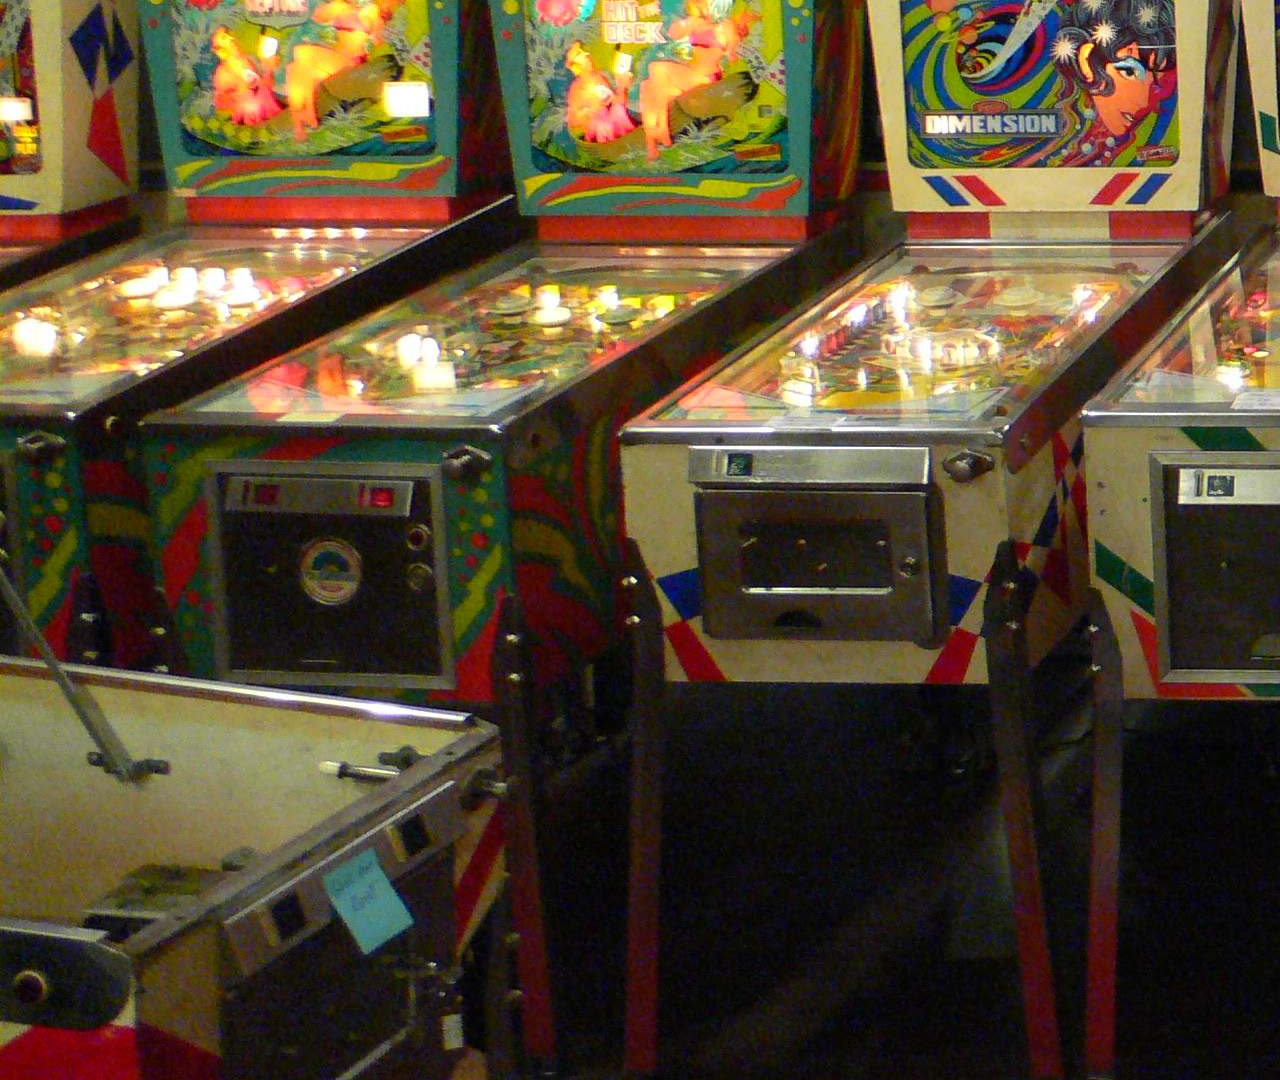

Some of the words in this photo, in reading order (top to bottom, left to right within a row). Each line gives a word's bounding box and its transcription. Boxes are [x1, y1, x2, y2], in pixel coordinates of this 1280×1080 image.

[602, 1, 639, 21] HIT
[604, 22, 667, 43] DECK
[925, 114, 1057, 134] DIMENSION
